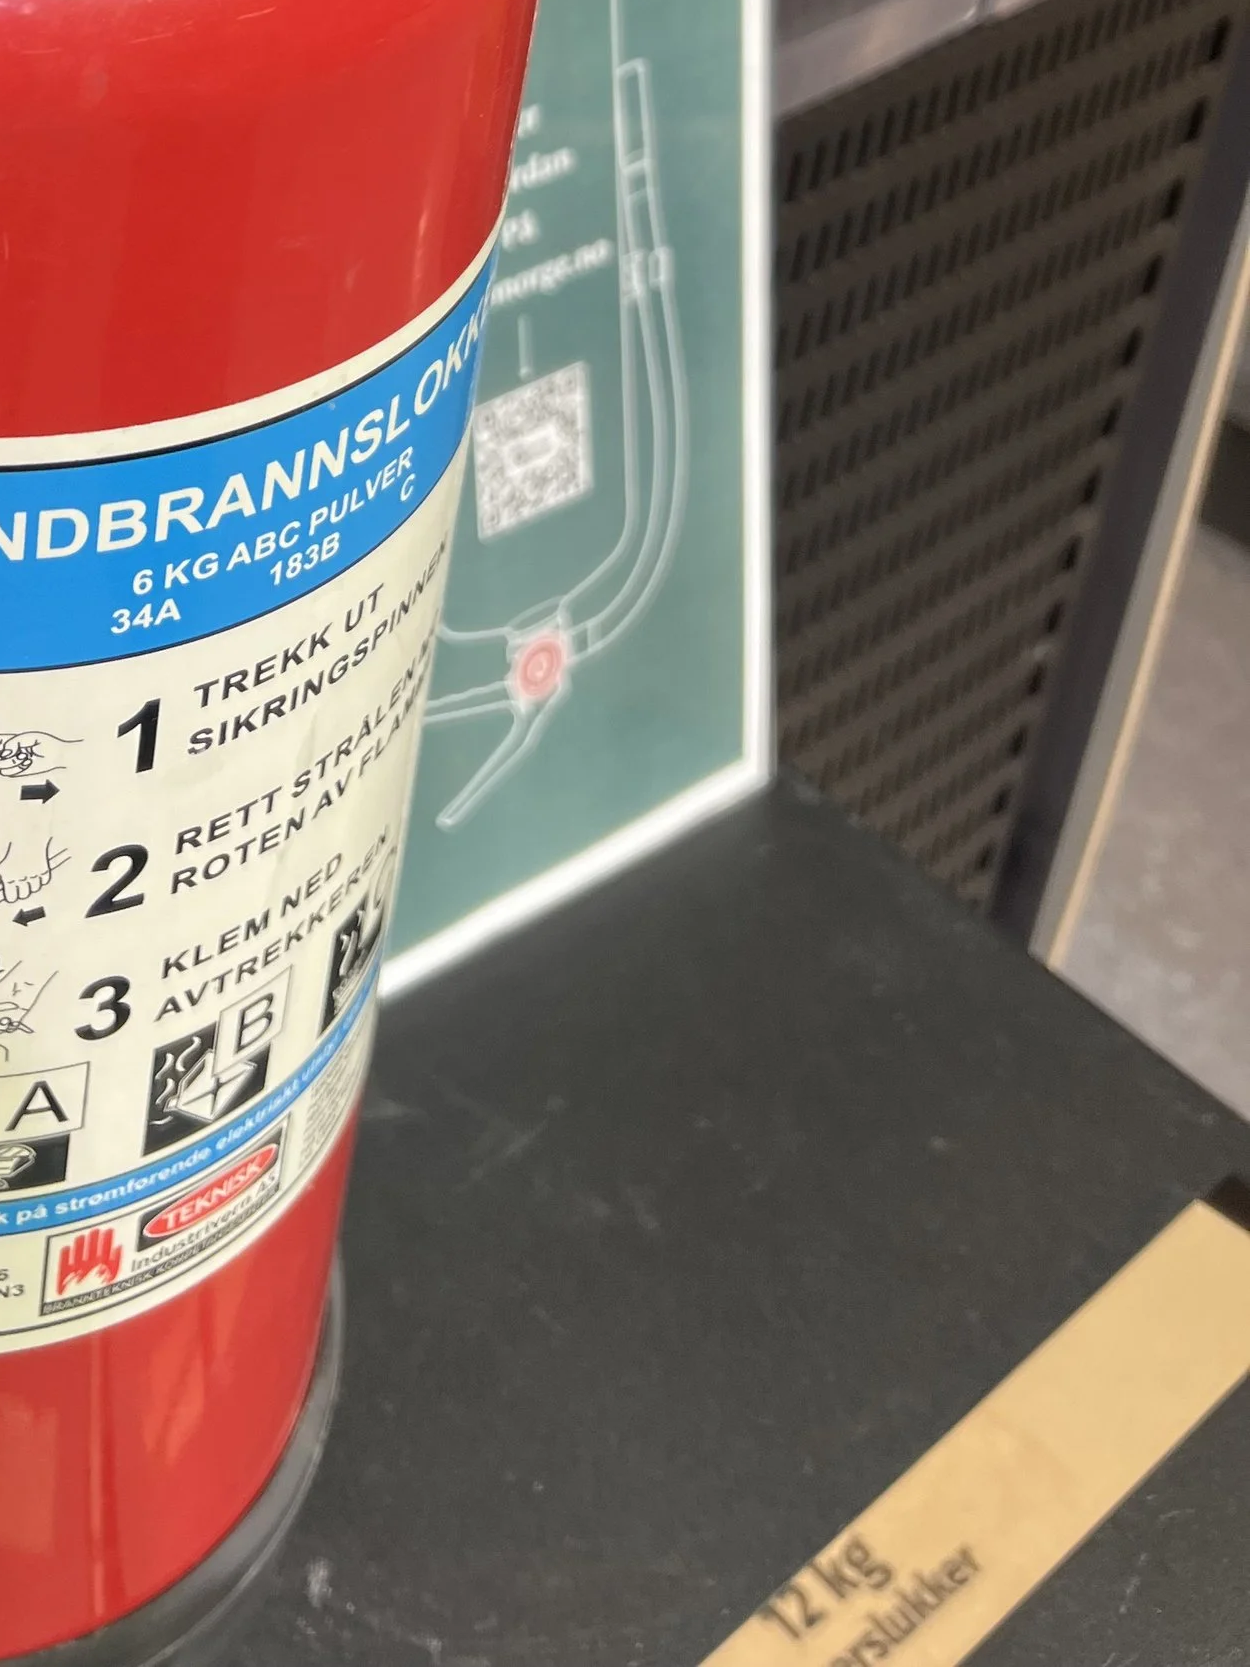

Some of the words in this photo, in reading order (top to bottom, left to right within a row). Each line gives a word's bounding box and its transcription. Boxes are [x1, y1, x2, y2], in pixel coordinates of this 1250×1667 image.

[110, 598, 181, 634] 34A
[269, 532, 341, 586] 183B
[399, 473, 416, 502] C
[132, 568, 154, 595] 6
[164, 552, 220, 589] KG
[225, 521, 301, 571] ABC
[309, 446, 413, 536] PULVER
[193, 621, 333, 708] TREKK
[343, 583, 385, 633] UT
[116, 698, 161, 774] 1
[175, 786, 282, 855] RETT
[290, 657, 415, 799] STRÅLEN
[84, 844, 149, 919] 2
[170, 807, 306, 895] ROTEN
[312, 767, 353, 820] AV
[153, 825, 390, 1023] AVTREKKEREN
[161, 907, 271, 979] KLEM
[280, 852, 343, 917] NED
[74, 975, 131, 1041] 3
[232, 993, 274, 1055] B
[4, 1080, 69, 1132] A
[16, 1204, 48, 1225] på
[54, 1146, 213, 1215] strømførende
[162, 1157, 262, 1231] TEKNISK
[762, 1583, 826, 1639] 12
[810, 1537, 893, 1600] kg
